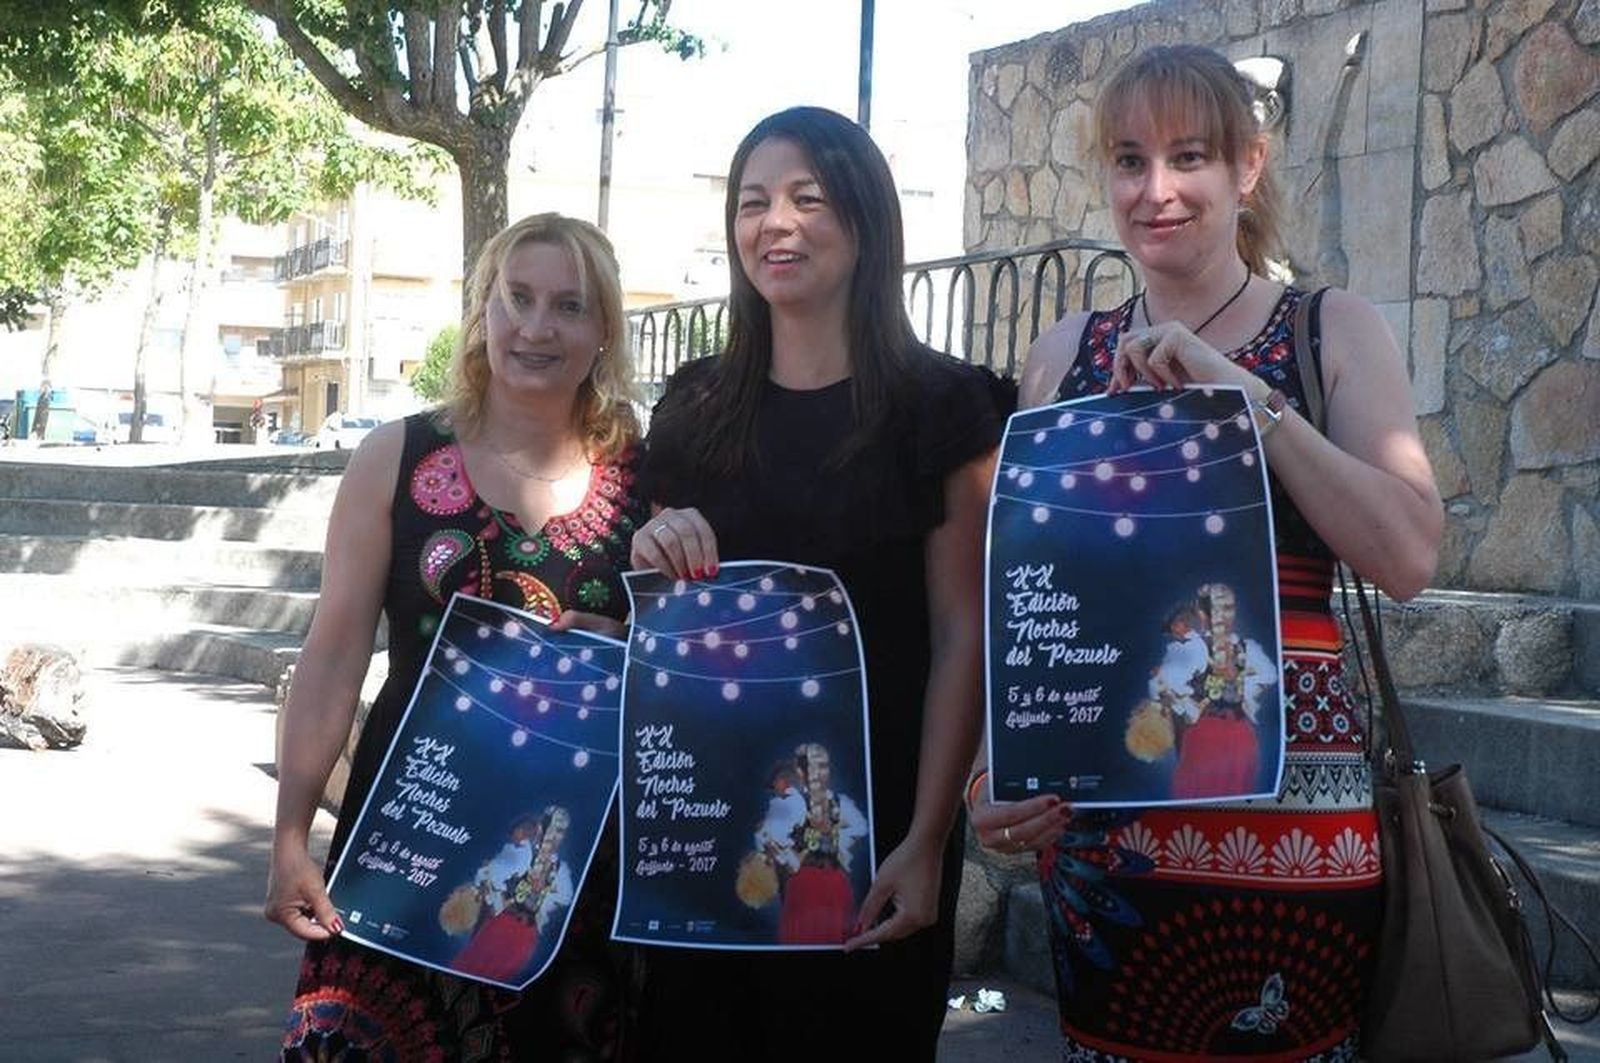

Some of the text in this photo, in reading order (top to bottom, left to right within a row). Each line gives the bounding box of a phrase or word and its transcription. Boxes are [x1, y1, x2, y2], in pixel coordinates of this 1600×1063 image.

[1006, 564, 1054, 590] XX
[1006, 591, 1080, 617] Edición
[1007, 618, 1080, 643] Noches
[1006, 643, 1122, 668] del Pozuelo
[1008, 686, 1020, 703] 5
[1019, 693, 1031, 707] y
[1035, 686, 1045, 703] 6
[1069, 706, 1104, 724] 2017
[406, 755, 461, 791] Edición
[636, 750, 696, 773] Edición
[396, 778, 451, 813] Noches
[636, 775, 696, 797] Noches
[636, 798, 731, 821] del Pozuelo
[381, 800, 473, 845] del Pozuelo
[390, 841, 400, 854] 6
[638, 837, 649, 852] 5
[648, 844, 658, 856] y
[661, 837, 669, 852] 6
[689, 856, 718, 872] 2017
[407, 867, 438, 888] 2017
